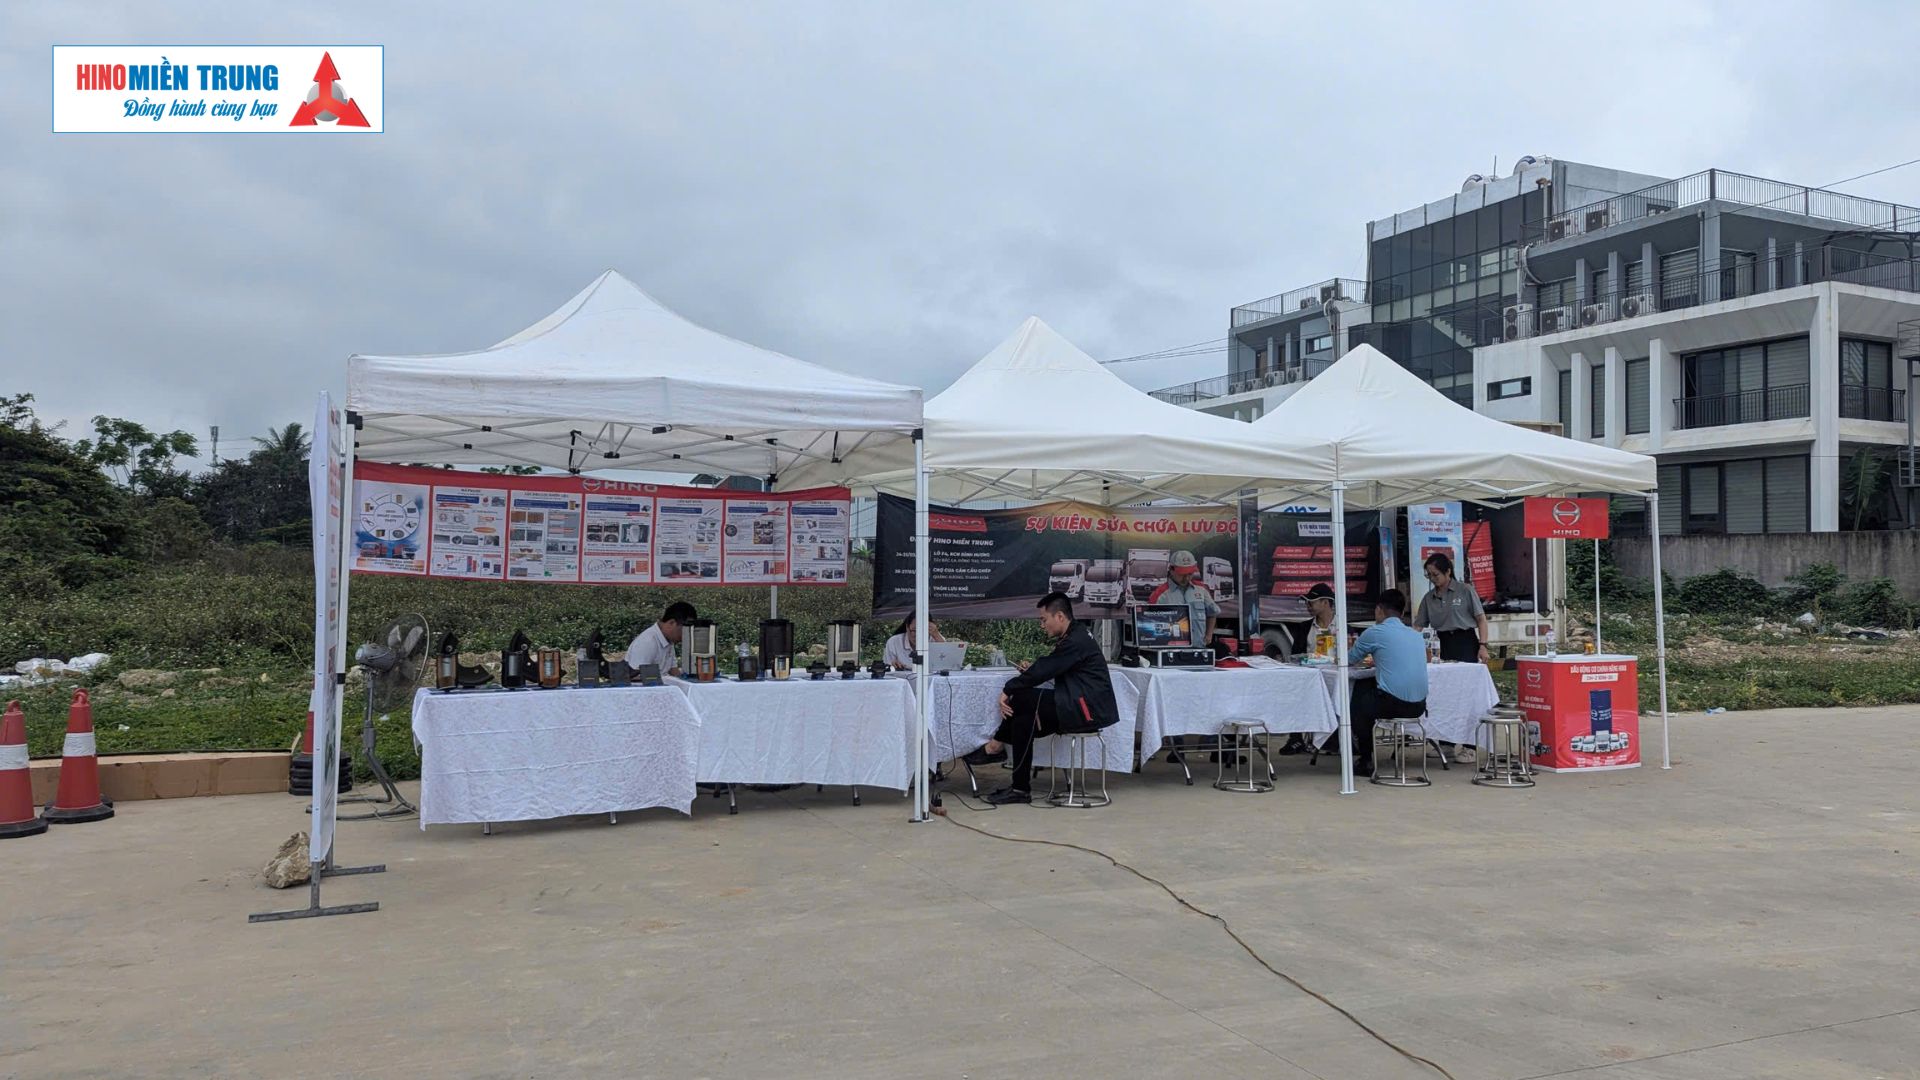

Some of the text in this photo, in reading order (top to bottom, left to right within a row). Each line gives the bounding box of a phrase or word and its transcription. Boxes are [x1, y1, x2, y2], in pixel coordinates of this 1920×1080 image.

[604, 481, 658, 492] HINO
[1025, 515, 1048, 534] SỰ
[1052, 513, 1093, 535] KIỆN
[1096, 514, 1128, 533] SỬA
[1132, 517, 1178, 534] CHỮA
[1182, 518, 1212, 534] LƯU
